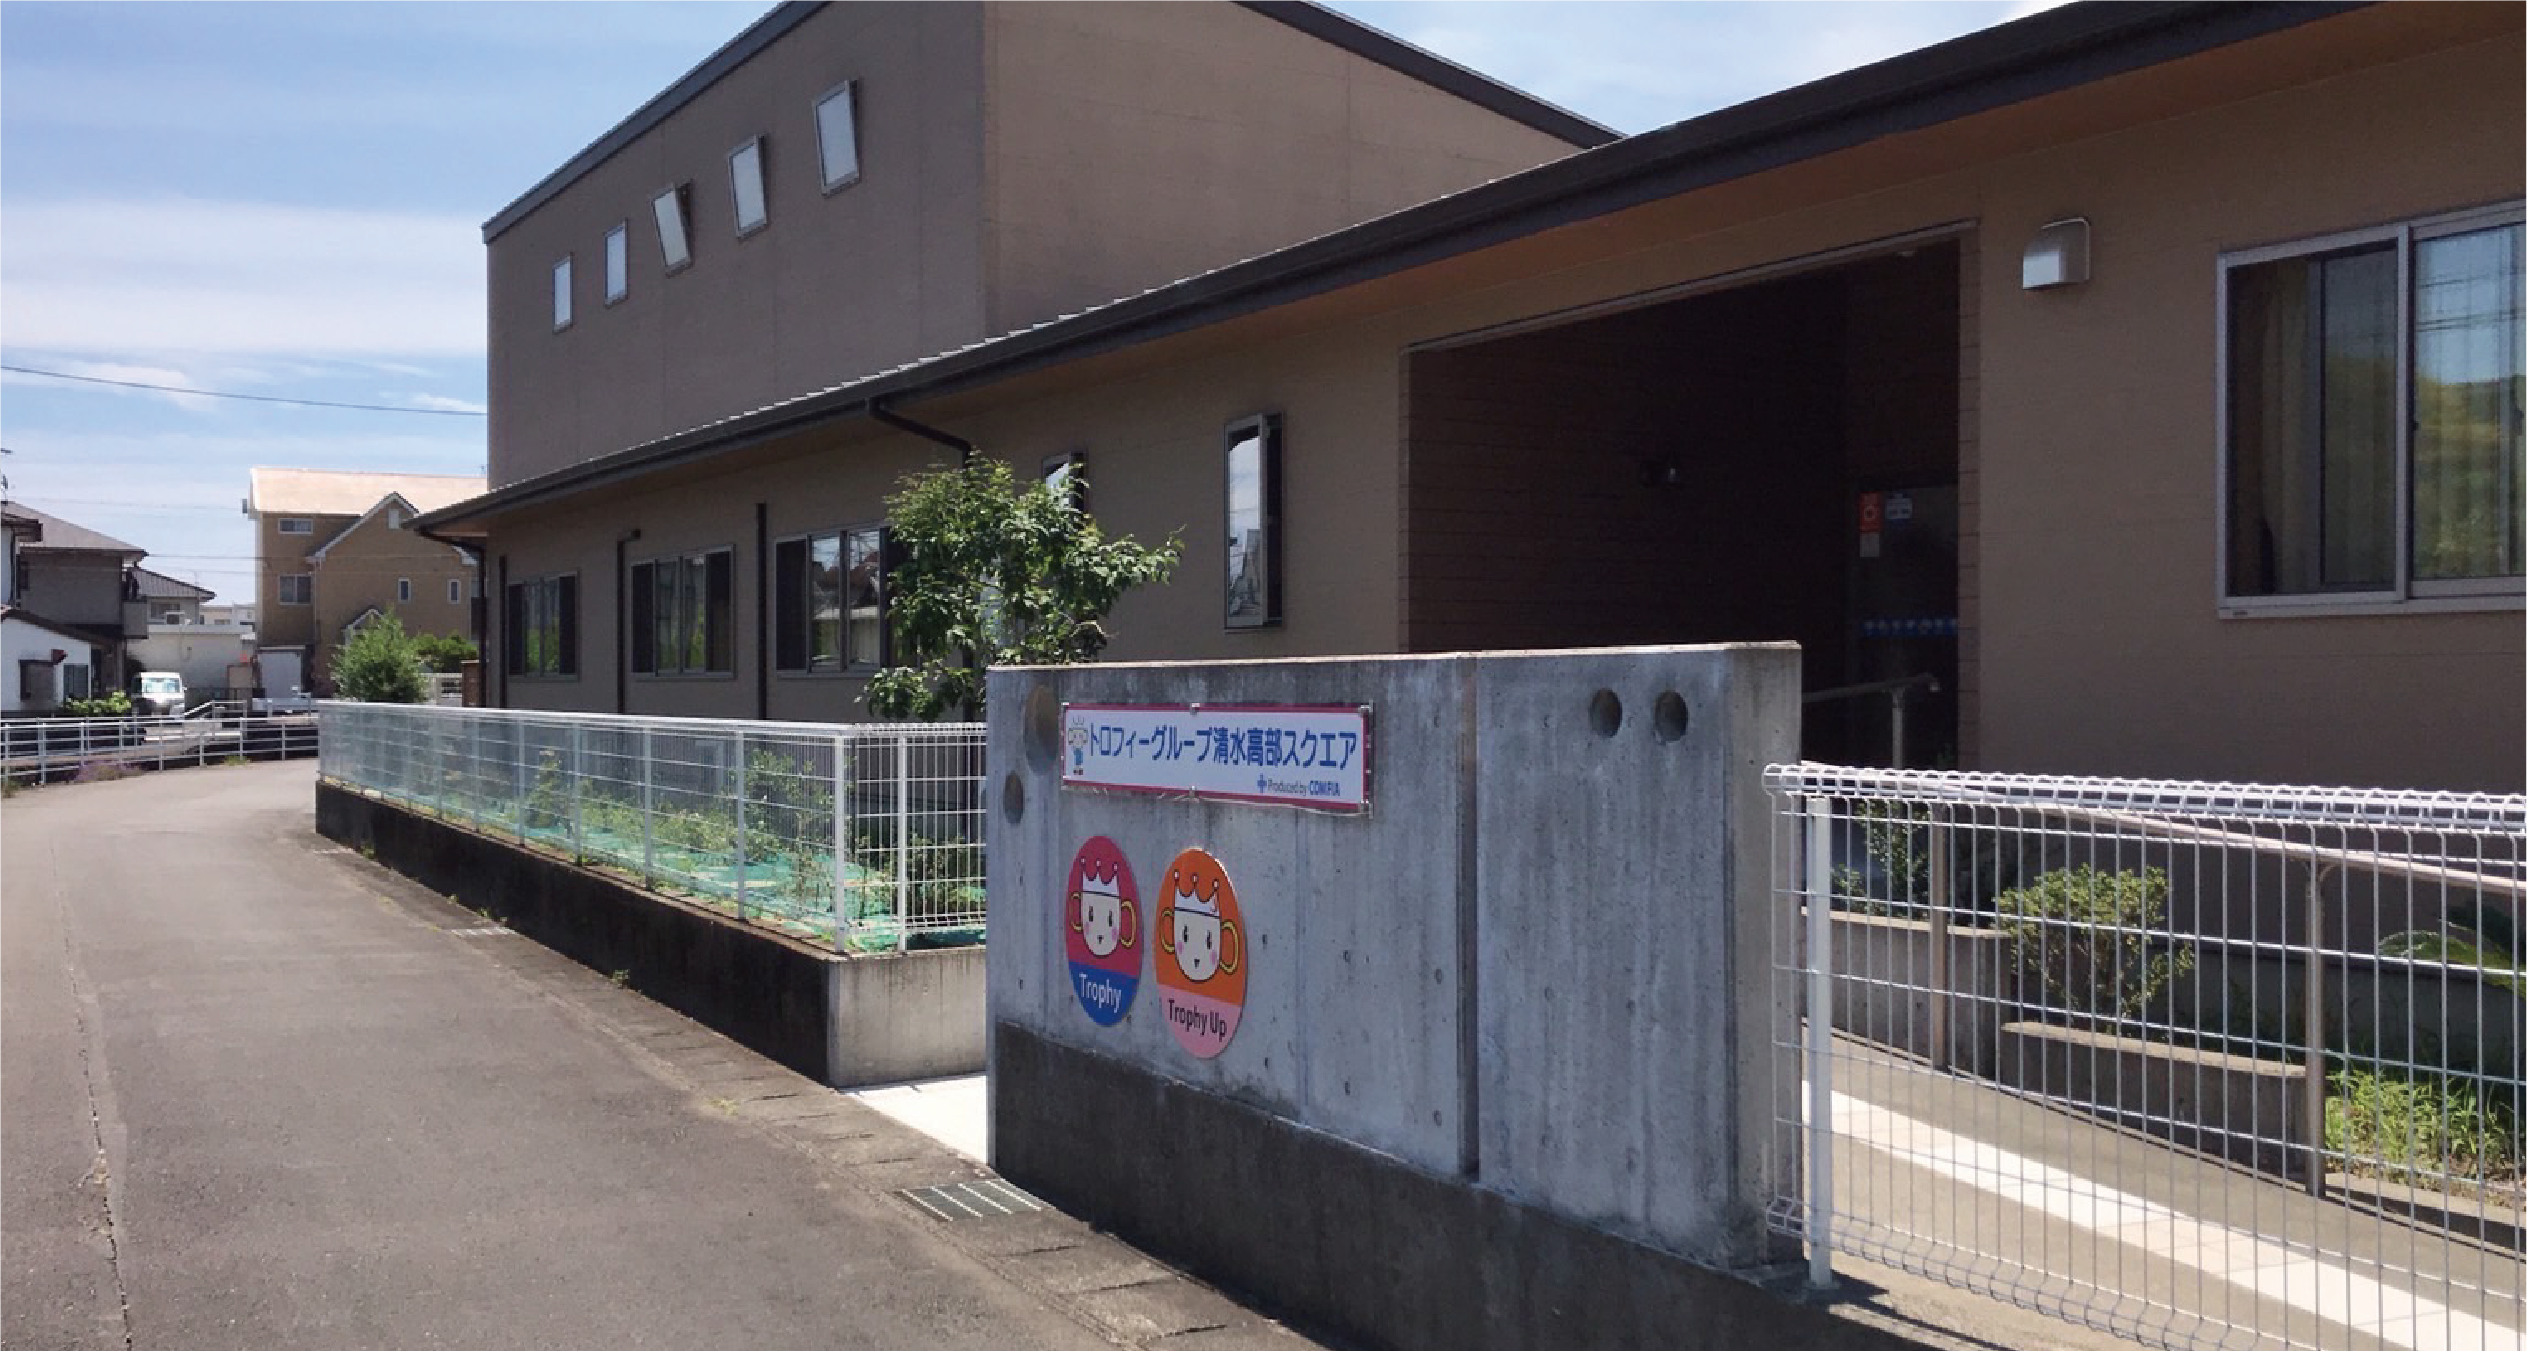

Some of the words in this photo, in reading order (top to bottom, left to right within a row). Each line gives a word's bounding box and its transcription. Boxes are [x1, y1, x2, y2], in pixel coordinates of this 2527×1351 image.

[1091, 723, 1357, 769] トロフィーグループ清水高部スクエア
[1267, 778, 1298, 794] Produced
[1079, 973, 1122, 1013] Trophy
[1168, 999, 1207, 1036] Trophy
[1210, 1012, 1227, 1042] Up
